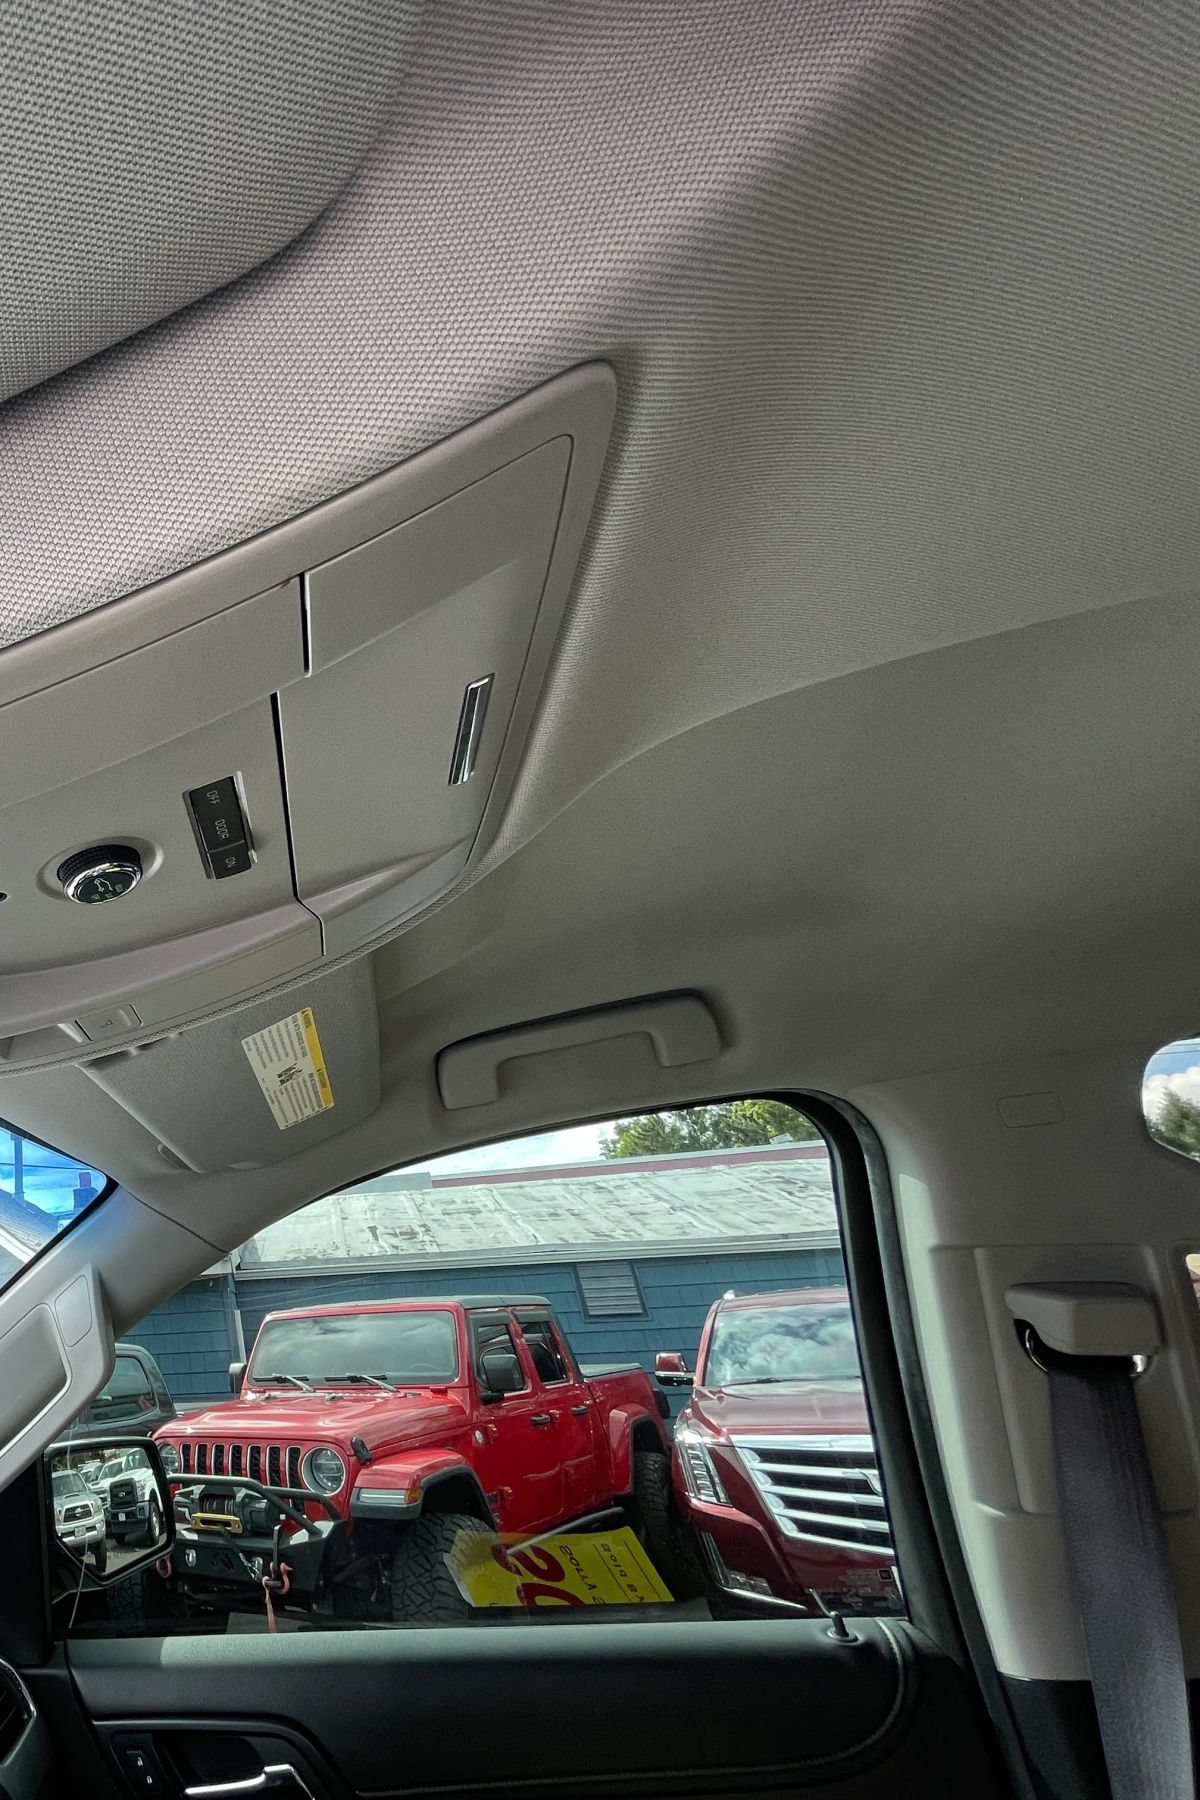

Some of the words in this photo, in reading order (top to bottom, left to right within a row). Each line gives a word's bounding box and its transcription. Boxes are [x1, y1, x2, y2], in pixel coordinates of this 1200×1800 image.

[207, 790, 220, 805] OFF
[215, 819, 230, 839] DOOR
[226, 857, 237, 868] ON
